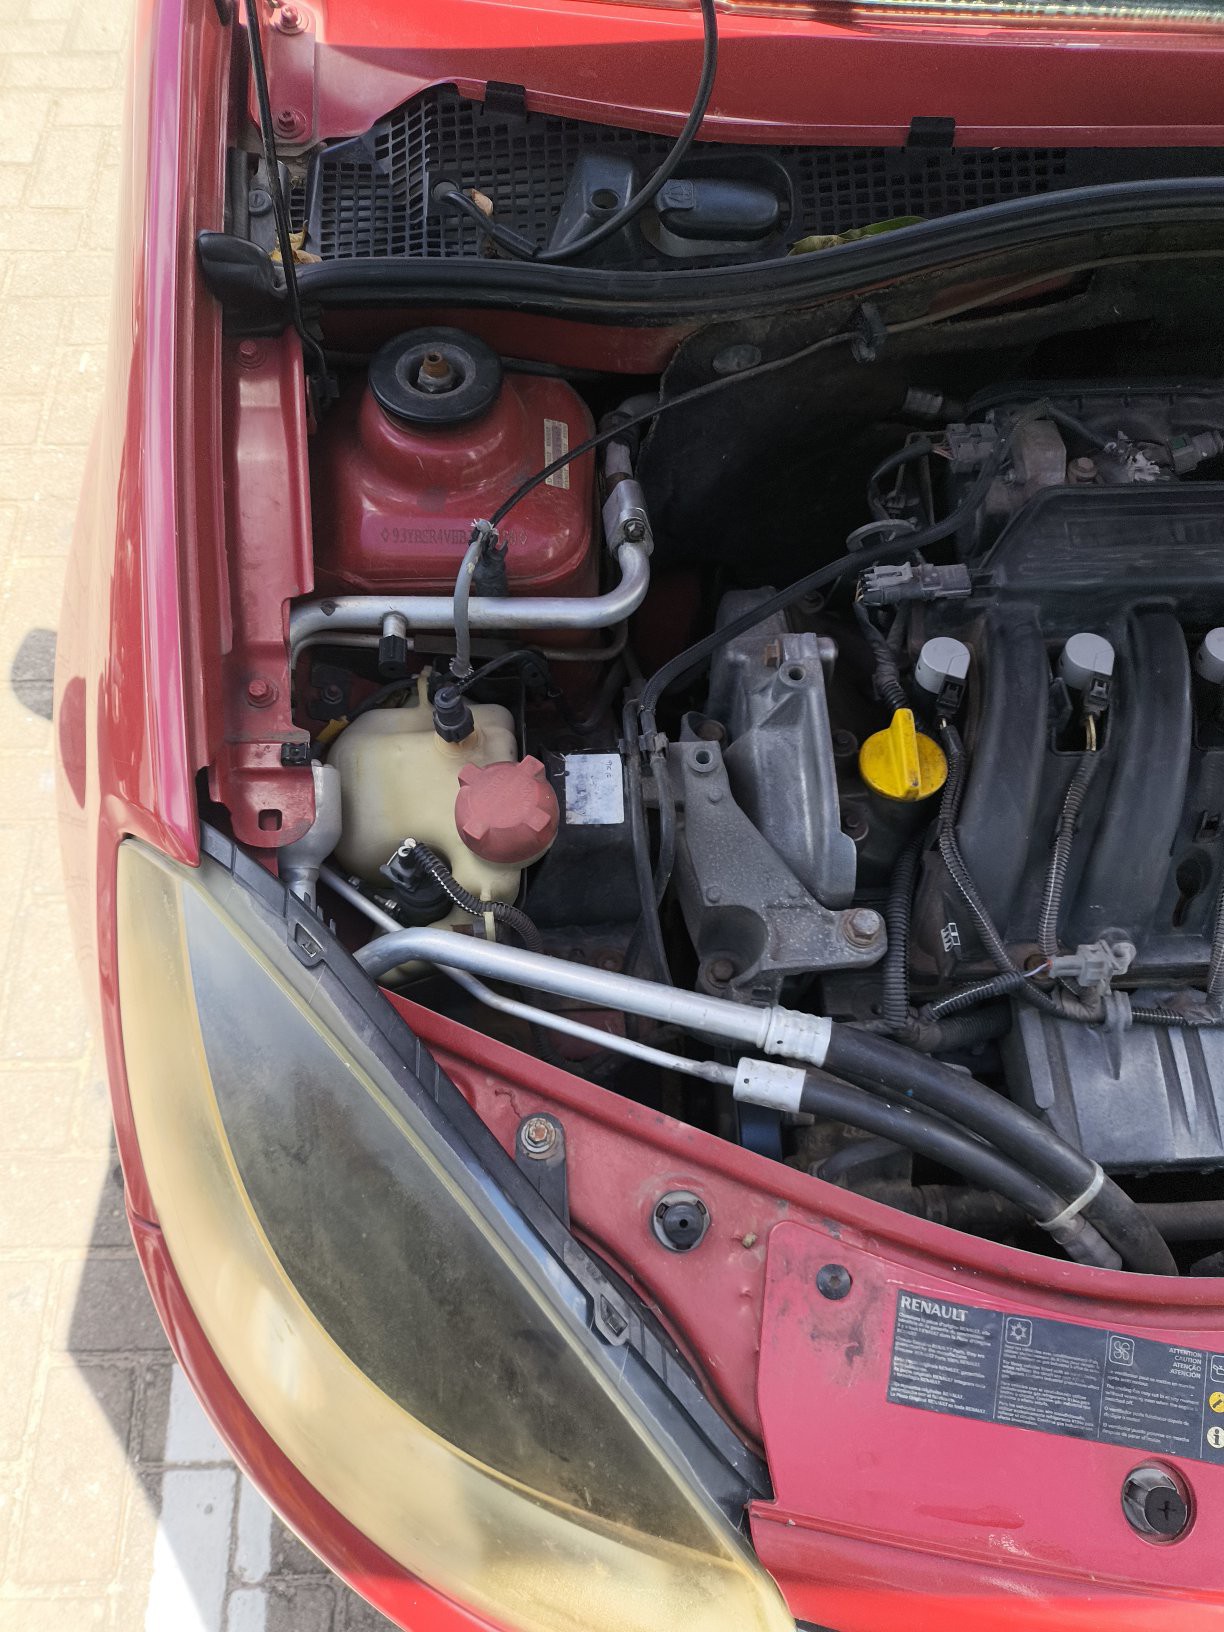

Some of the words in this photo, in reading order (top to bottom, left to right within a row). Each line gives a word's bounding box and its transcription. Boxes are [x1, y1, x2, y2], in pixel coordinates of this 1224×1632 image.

[900, 1296, 968, 1322] RENAULT
[1169, 1348, 1202, 1358] ATTENTION
[1175, 1355, 1202, 1365] CAUTION
[1173, 1362, 1201, 1372] ATENÇÃO
